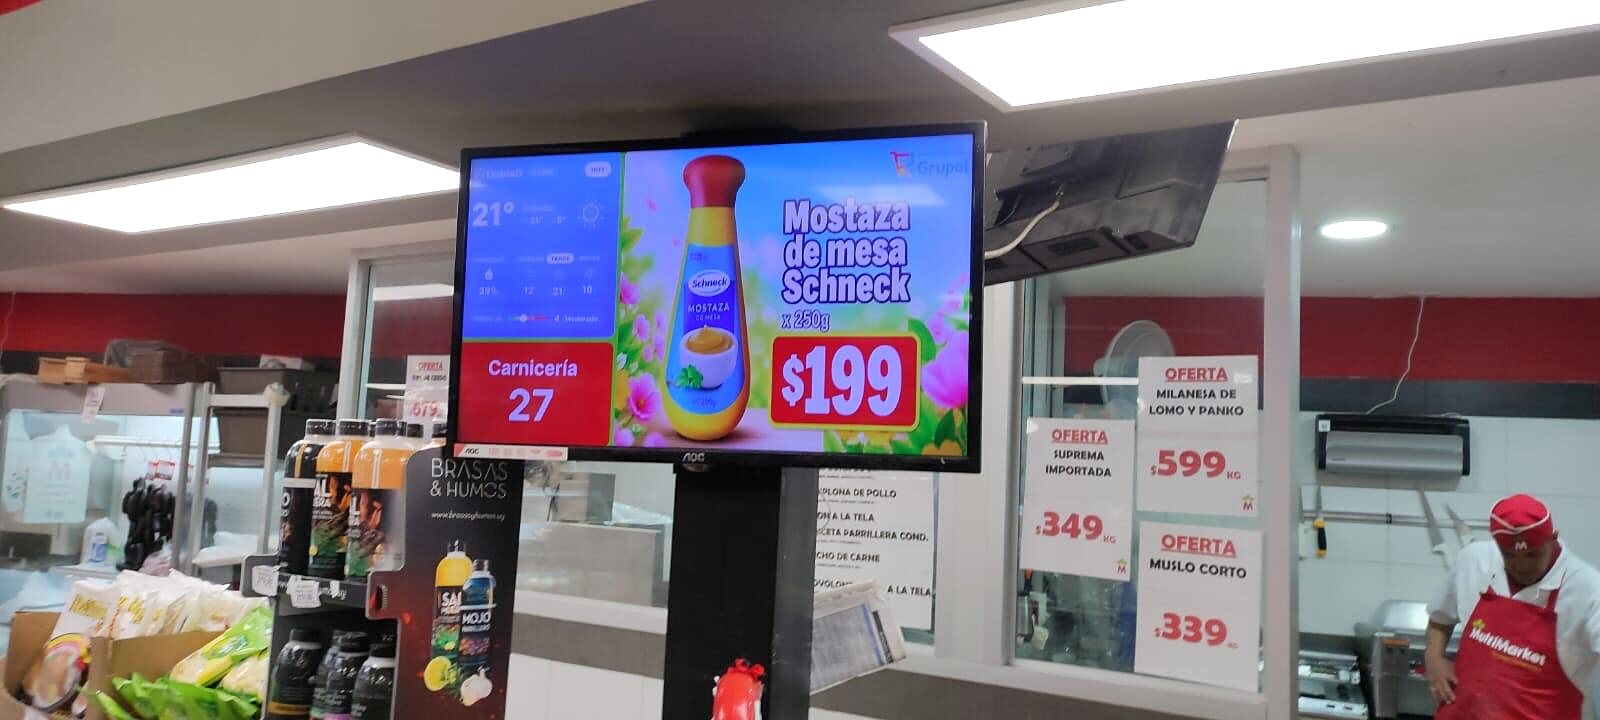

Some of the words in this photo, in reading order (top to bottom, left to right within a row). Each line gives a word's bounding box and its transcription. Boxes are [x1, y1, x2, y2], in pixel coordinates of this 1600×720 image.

[471, 201, 515, 227] 21°
[784, 197, 911, 233] Mostaza
[784, 233, 821, 268] de
[826, 237, 907, 267] mesa
[692, 277, 728, 290] Schneck
[781, 267, 911, 304] Schneck
[687, 302, 730, 314] MOSTAZA
[782, 313, 791, 328] x
[793, 310, 830, 332] 250g
[488, 358, 578, 377] Carnicería
[1165, 367, 1229, 382] OFERTA
[781, 344, 903, 417] $199
[1156, 388, 1217, 400] MILANESA
[1220, 389, 1237, 400] DE
[508, 387, 554, 423] 27
[1149, 404, 1185, 416] LOMO
[1187, 405, 1196, 416] Y
[1199, 405, 1245, 417] PANKO
[1051, 428, 1109, 445] OFERTA
[1053, 449, 1105, 461] SUPREMA
[430, 457, 509, 481] BRASAS
[1045, 464, 1112, 478] IMPORTADA
[1226, 471, 1242, 480] KG
[429, 479, 442, 498] &
[446, 482, 507, 500] HUMOS
[853, 488, 865, 497] DE
[866, 488, 897, 498] POLLO
[832, 512, 838, 520] A
[840, 512, 851, 521] LA
[853, 513, 875, 522] TELA
[843, 529, 898, 540] PARRILLERA
[1103, 536, 1117, 544] KG
[1160, 533, 1237, 559] OFERTA
[1514, 541, 1528, 551] M
[836, 552, 849, 561] DE
[849, 552, 880, 563] CARNE
[1149, 558, 1196, 574] MUSLO
[1199, 563, 1248, 579] CORTO
[887, 585, 894, 593] A
[896, 586, 908, 595] LA
[910, 587, 931, 597] TELA
[462, 611, 492, 626] MOJO
